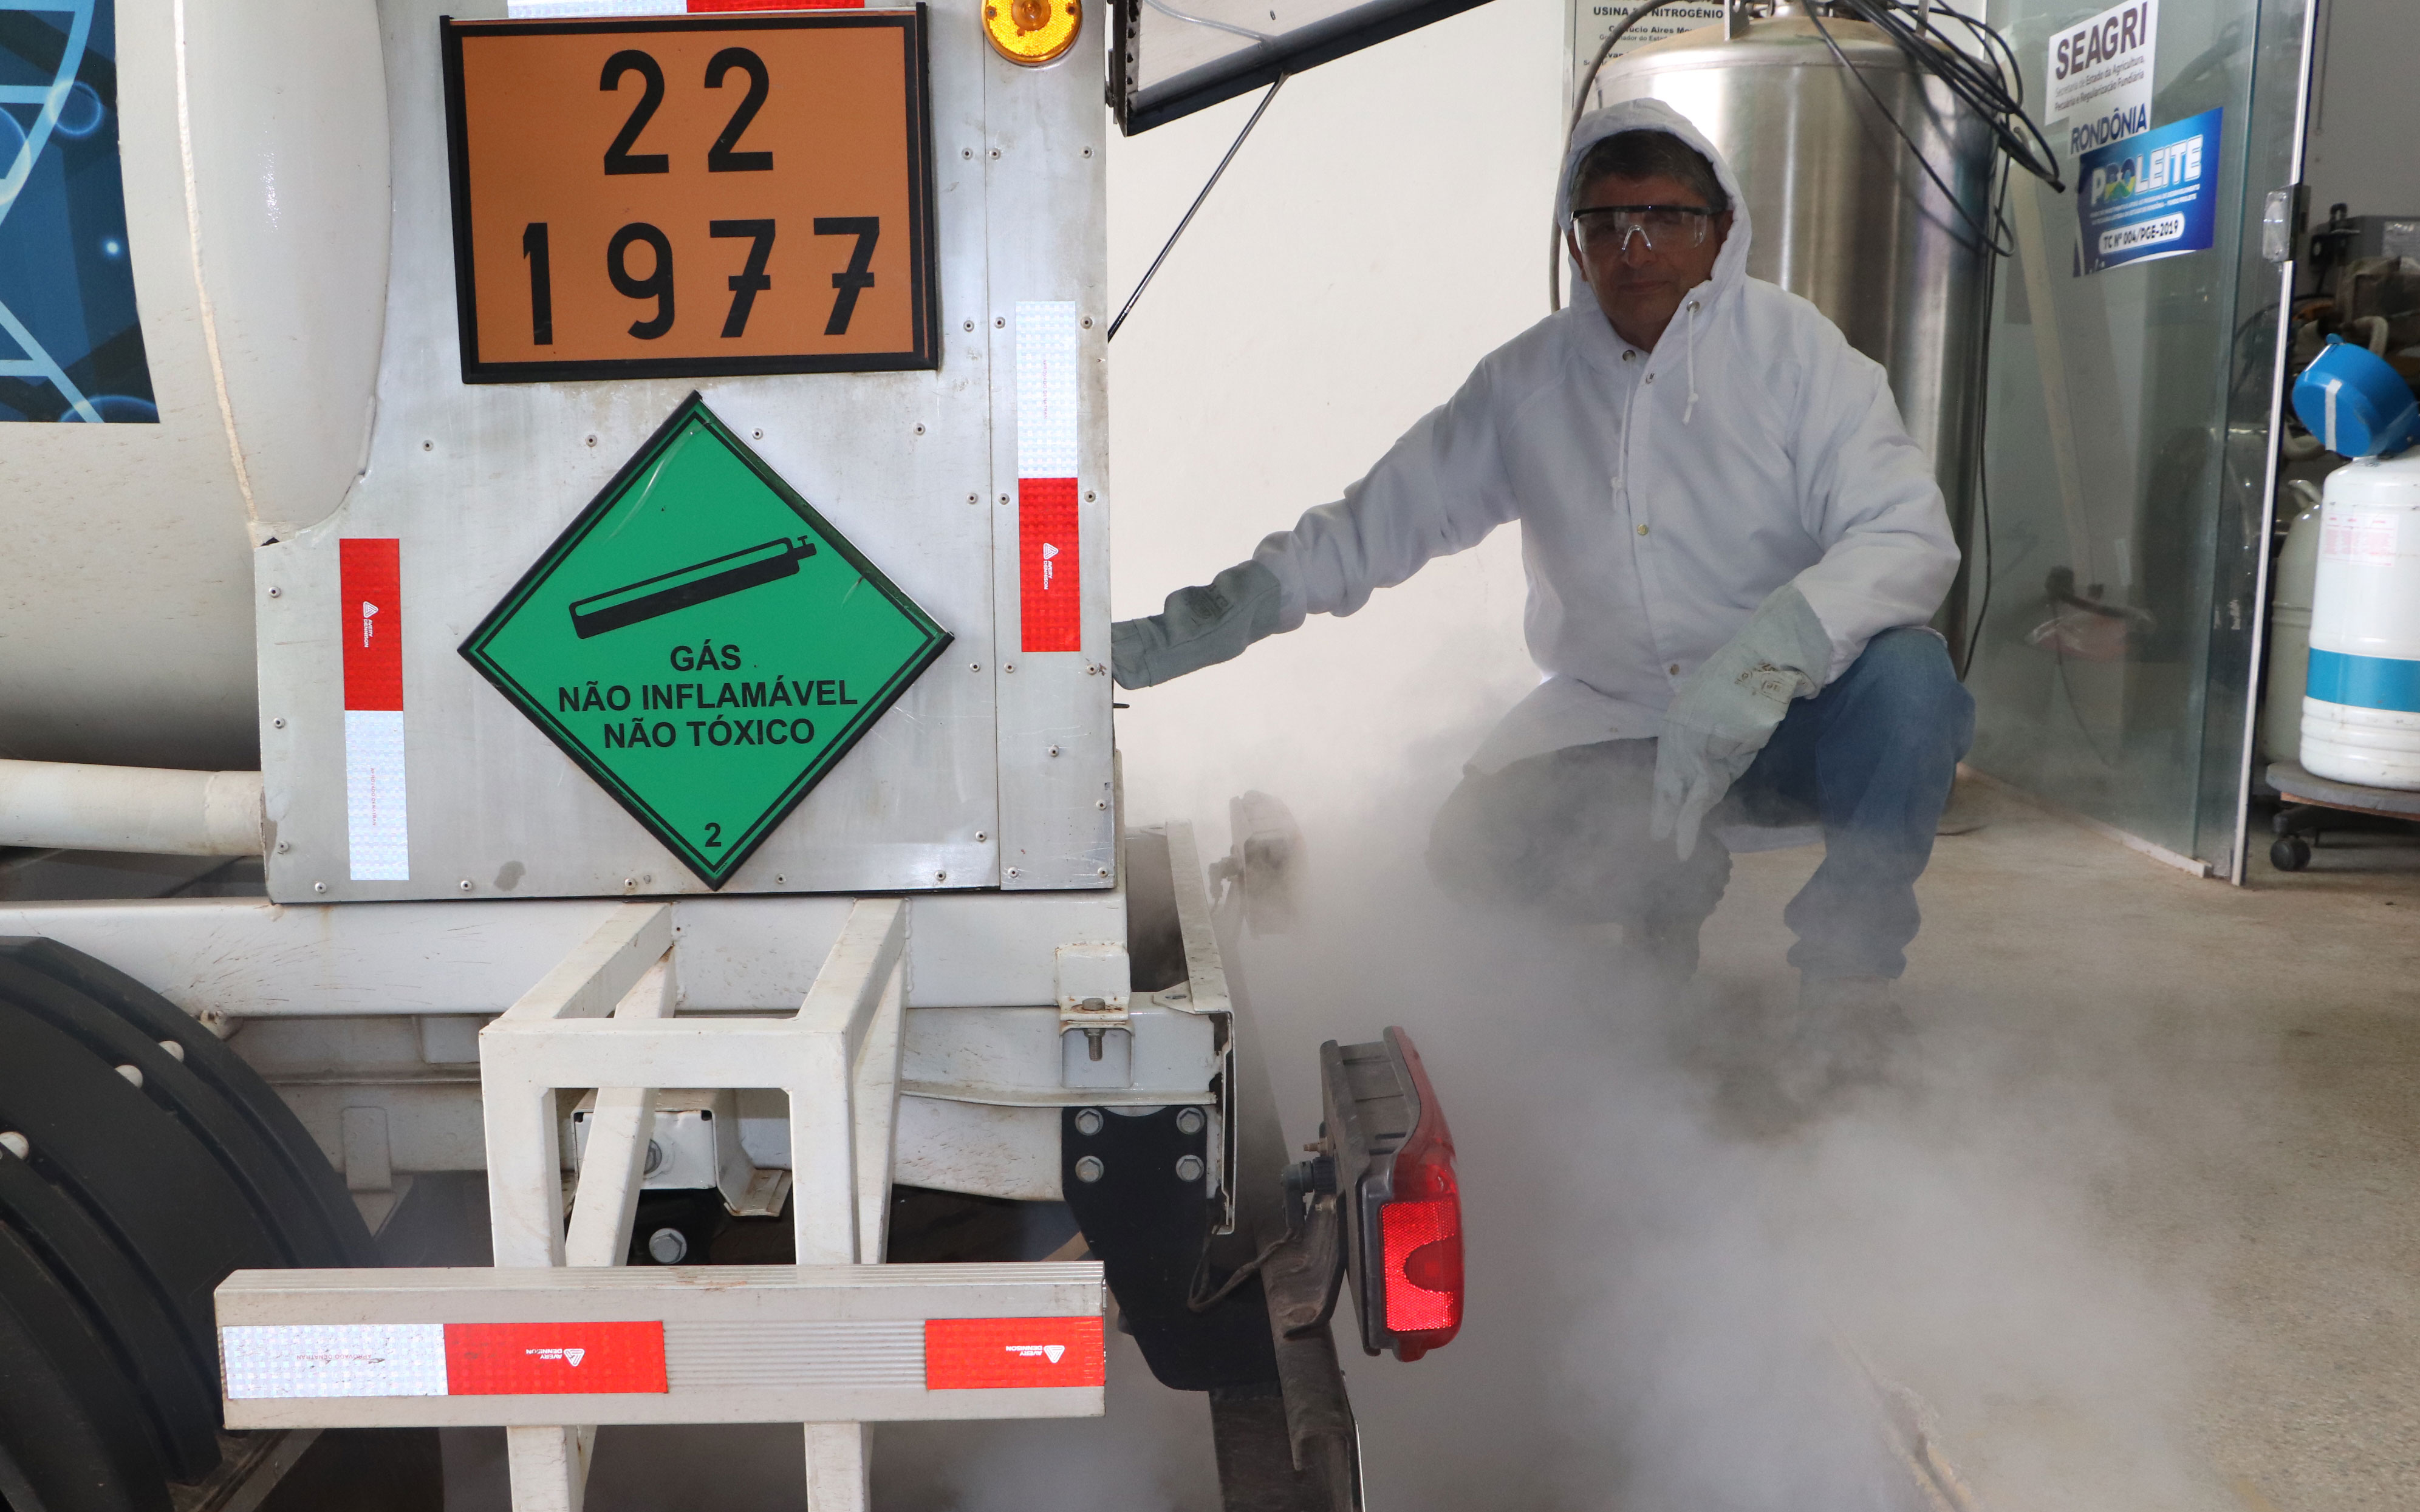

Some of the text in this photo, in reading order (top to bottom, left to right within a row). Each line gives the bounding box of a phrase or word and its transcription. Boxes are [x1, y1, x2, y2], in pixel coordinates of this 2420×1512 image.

[1593, 6, 1629, 16] USINA
[1652, 7, 1724, 19] NITROGÊNIO
[2056, 1, 2147, 80] SEAGRI
[600, 47, 773, 175] 22
[2071, 103, 2147, 155] RONDÔNIA
[2091, 134, 2203, 207] PROLEITE
[2104, 234, 2113, 250] TC
[522, 216, 880, 346] 1977
[670, 639, 742, 672] GÁS
[558, 675, 858, 712] NÃO INFLAMÁVEL
[604, 714, 815, 749] NÃO TÓXICO
[704, 822, 722, 848] 2
